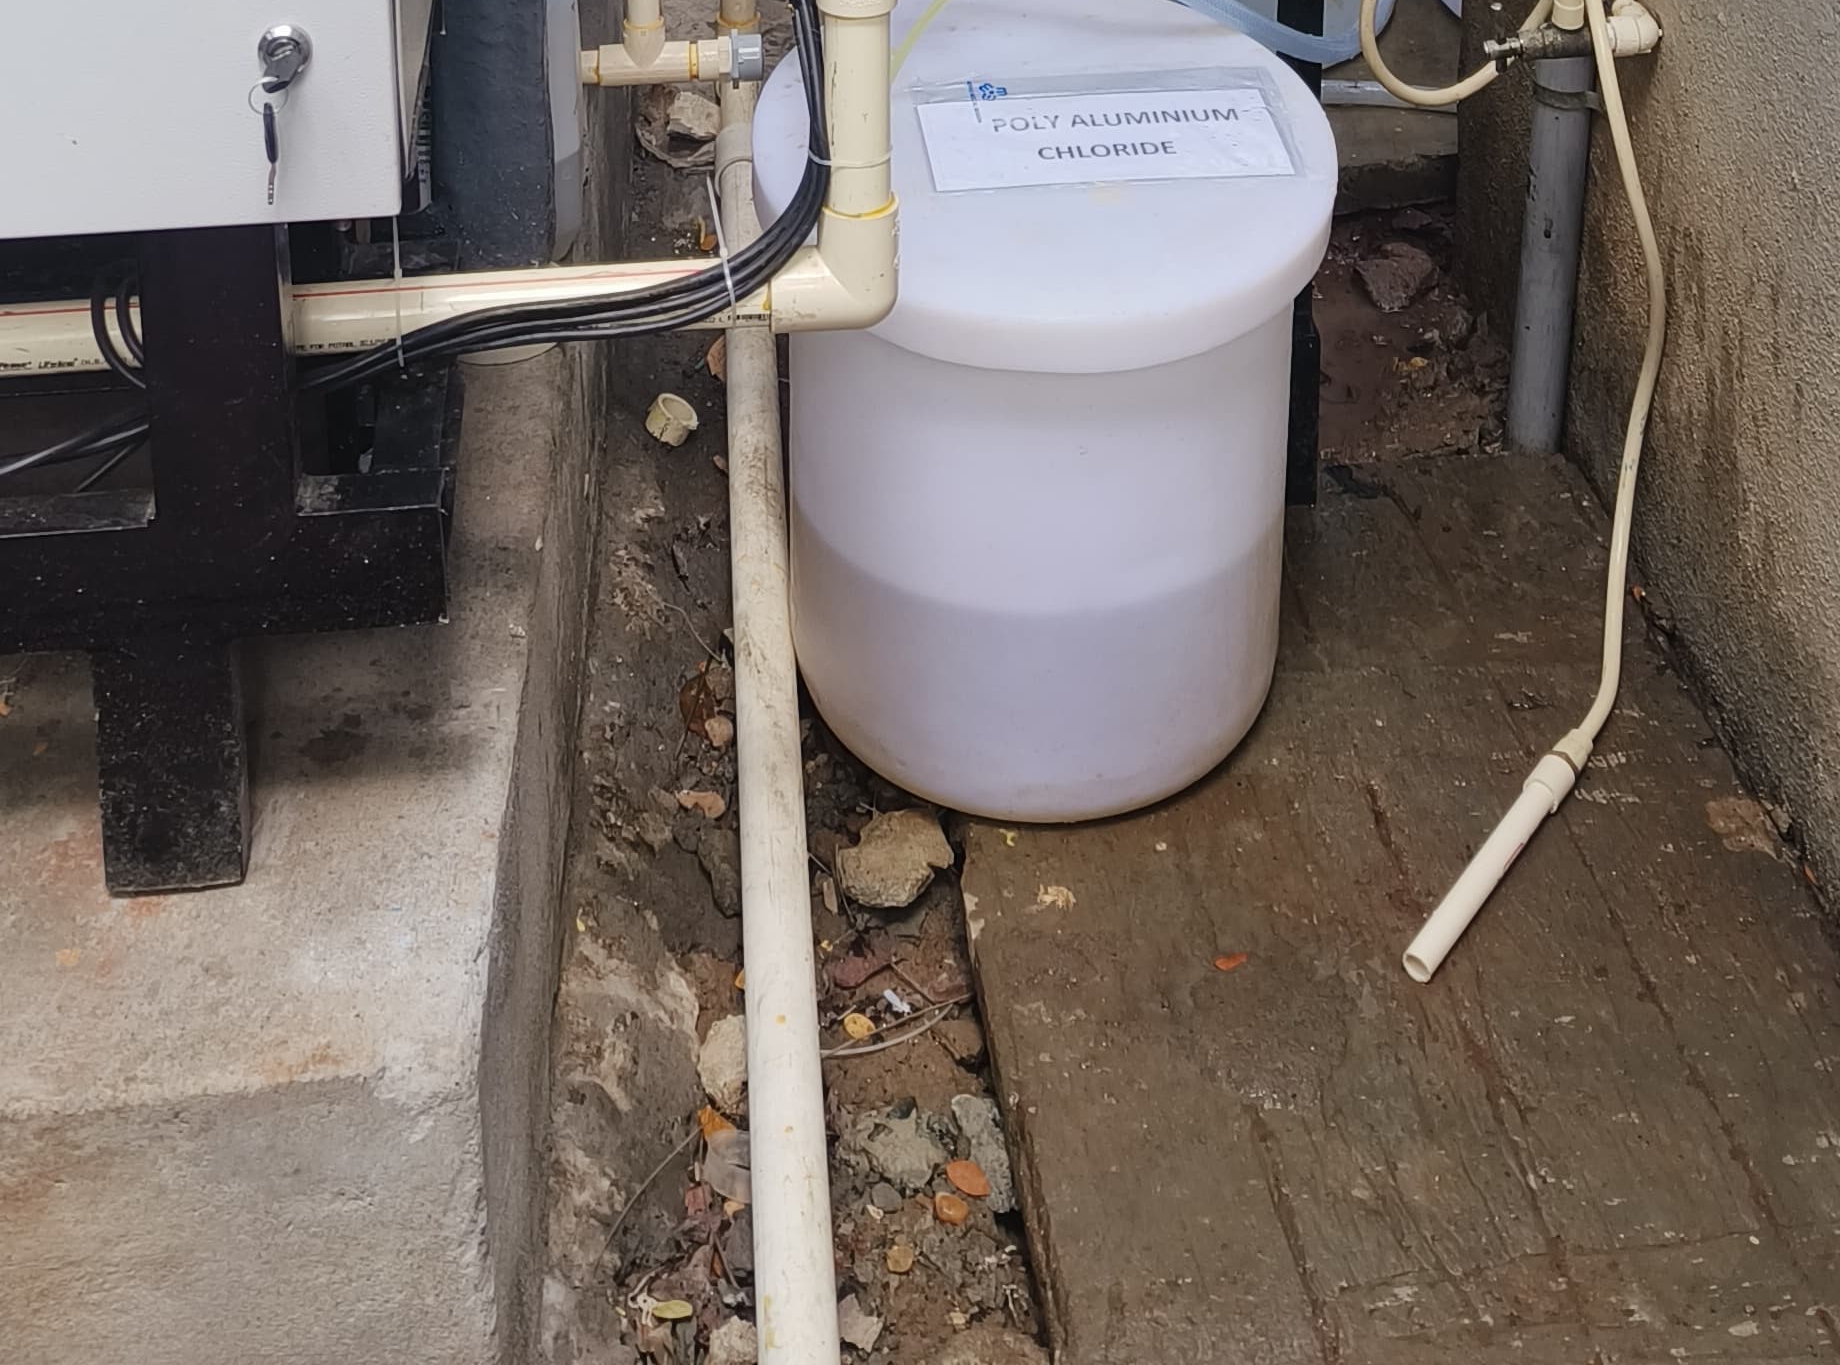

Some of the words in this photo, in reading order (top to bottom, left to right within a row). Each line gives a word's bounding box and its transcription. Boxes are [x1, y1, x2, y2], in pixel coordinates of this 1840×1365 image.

[991, 114, 1060, 133] POLY
[1070, 107, 1240, 130] ALUMINIUM
[1037, 140, 1177, 161] CHLORIDE
